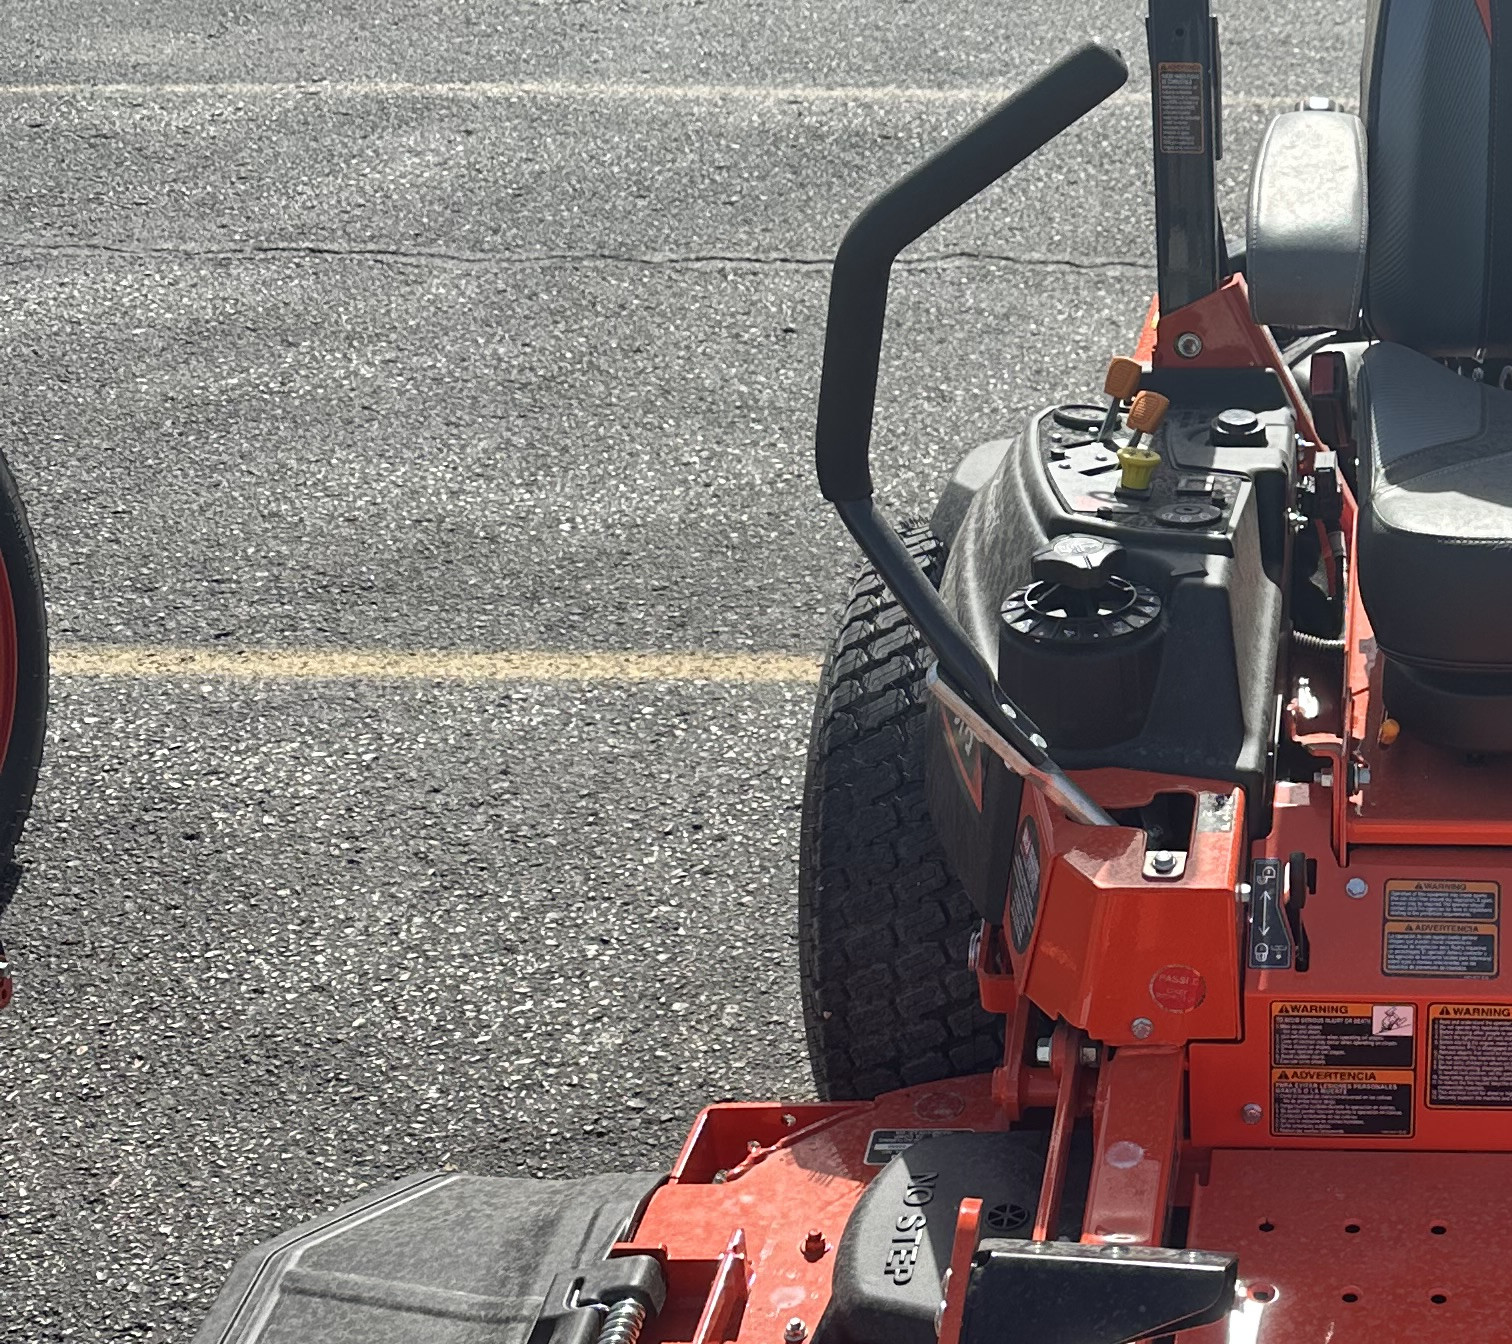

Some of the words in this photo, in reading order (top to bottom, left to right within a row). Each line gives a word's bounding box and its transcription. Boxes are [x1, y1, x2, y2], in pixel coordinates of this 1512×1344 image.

[1415, 924, 1479, 932] ADVERTENCIA
[1289, 1005, 1348, 1014] WARNING
[1453, 1009, 1511, 1017] WARNING
[1291, 1071, 1377, 1081] ADVERTENCIA
[903, 1171, 938, 1207] NO
[884, 1212, 927, 1285] STEP
